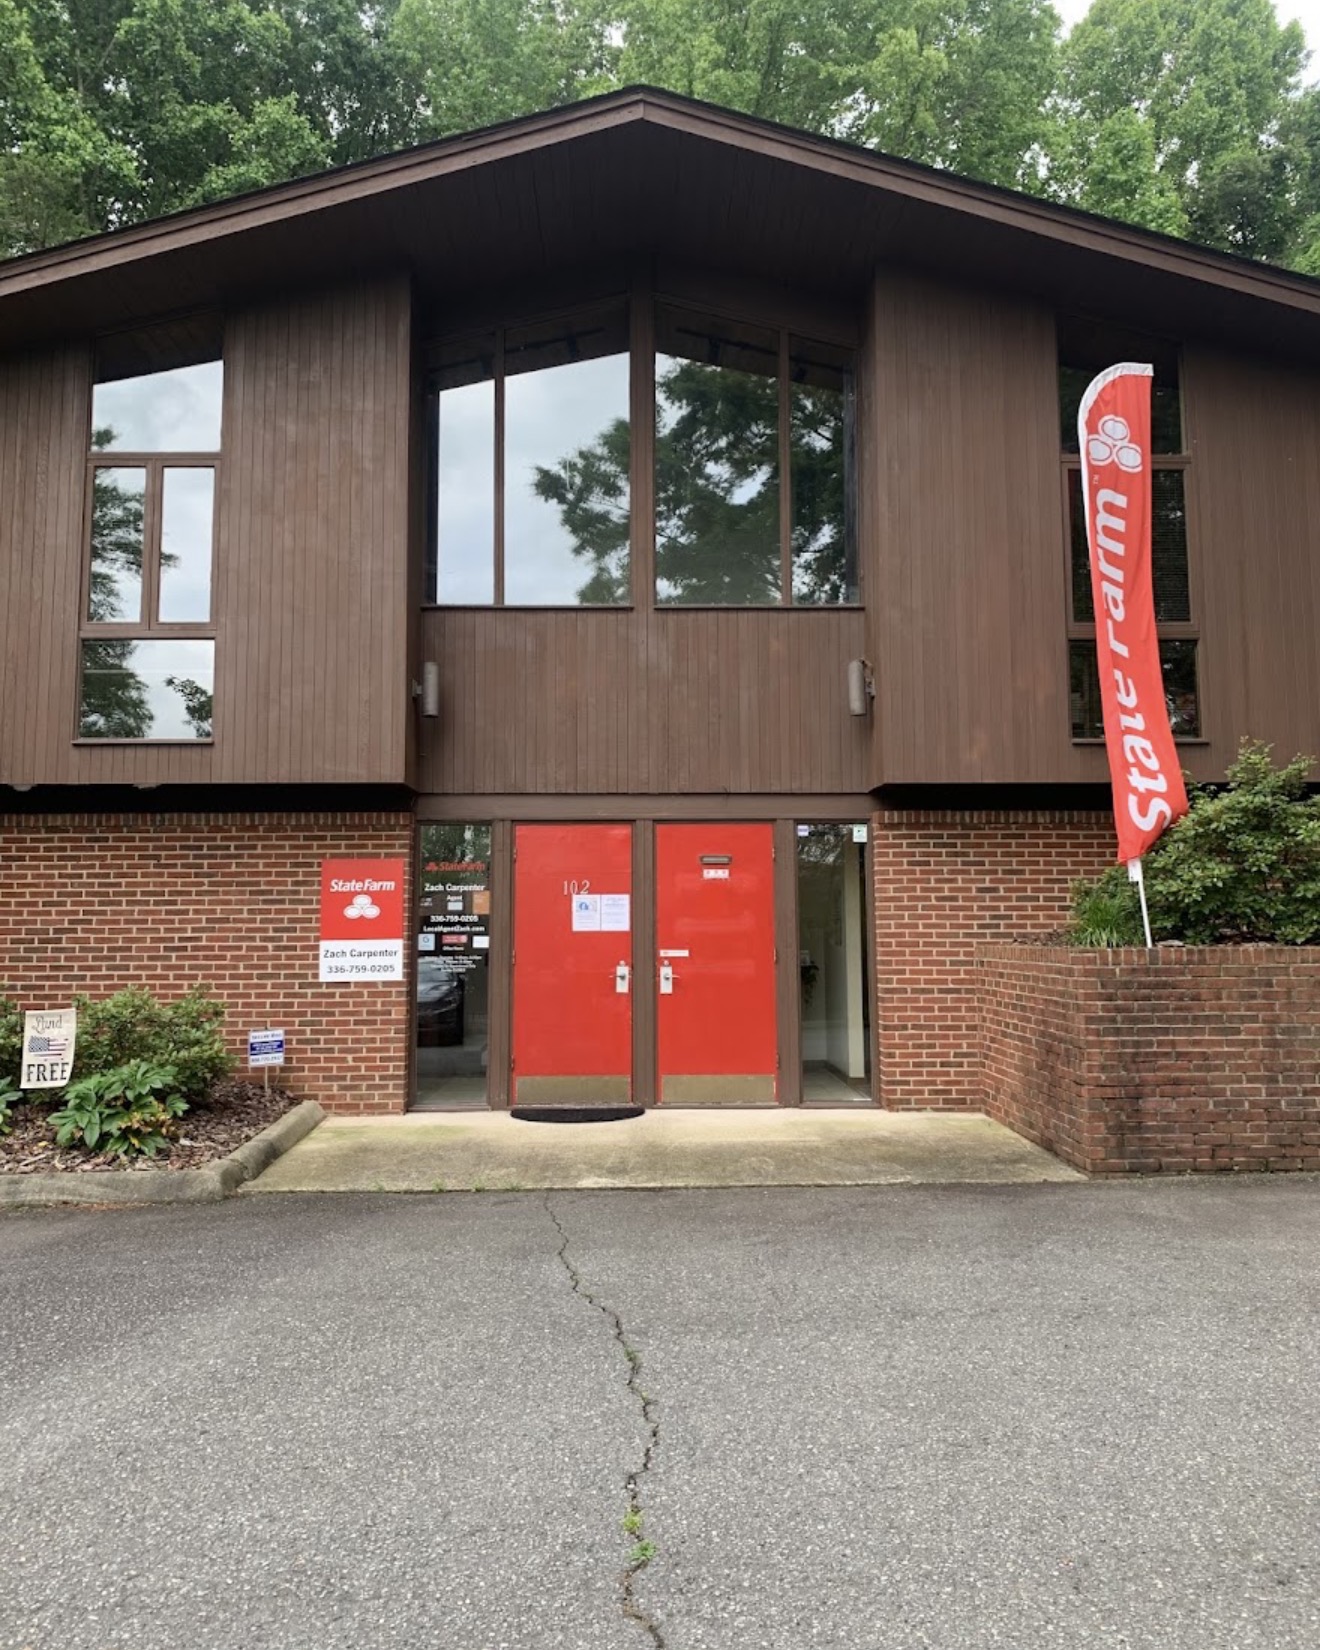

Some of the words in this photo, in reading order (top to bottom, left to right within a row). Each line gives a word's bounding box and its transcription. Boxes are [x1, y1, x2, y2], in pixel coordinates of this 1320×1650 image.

[424, 883, 444, 891] Zach
[446, 883, 485, 893] Carpenter
[564, 880, 590, 895] 102
[323, 949, 347, 959] Zach
[349, 948, 399, 959] Carpenter
[326, 965, 396, 974] 336-759-0205
[26, 1062, 69, 1082] FREE
